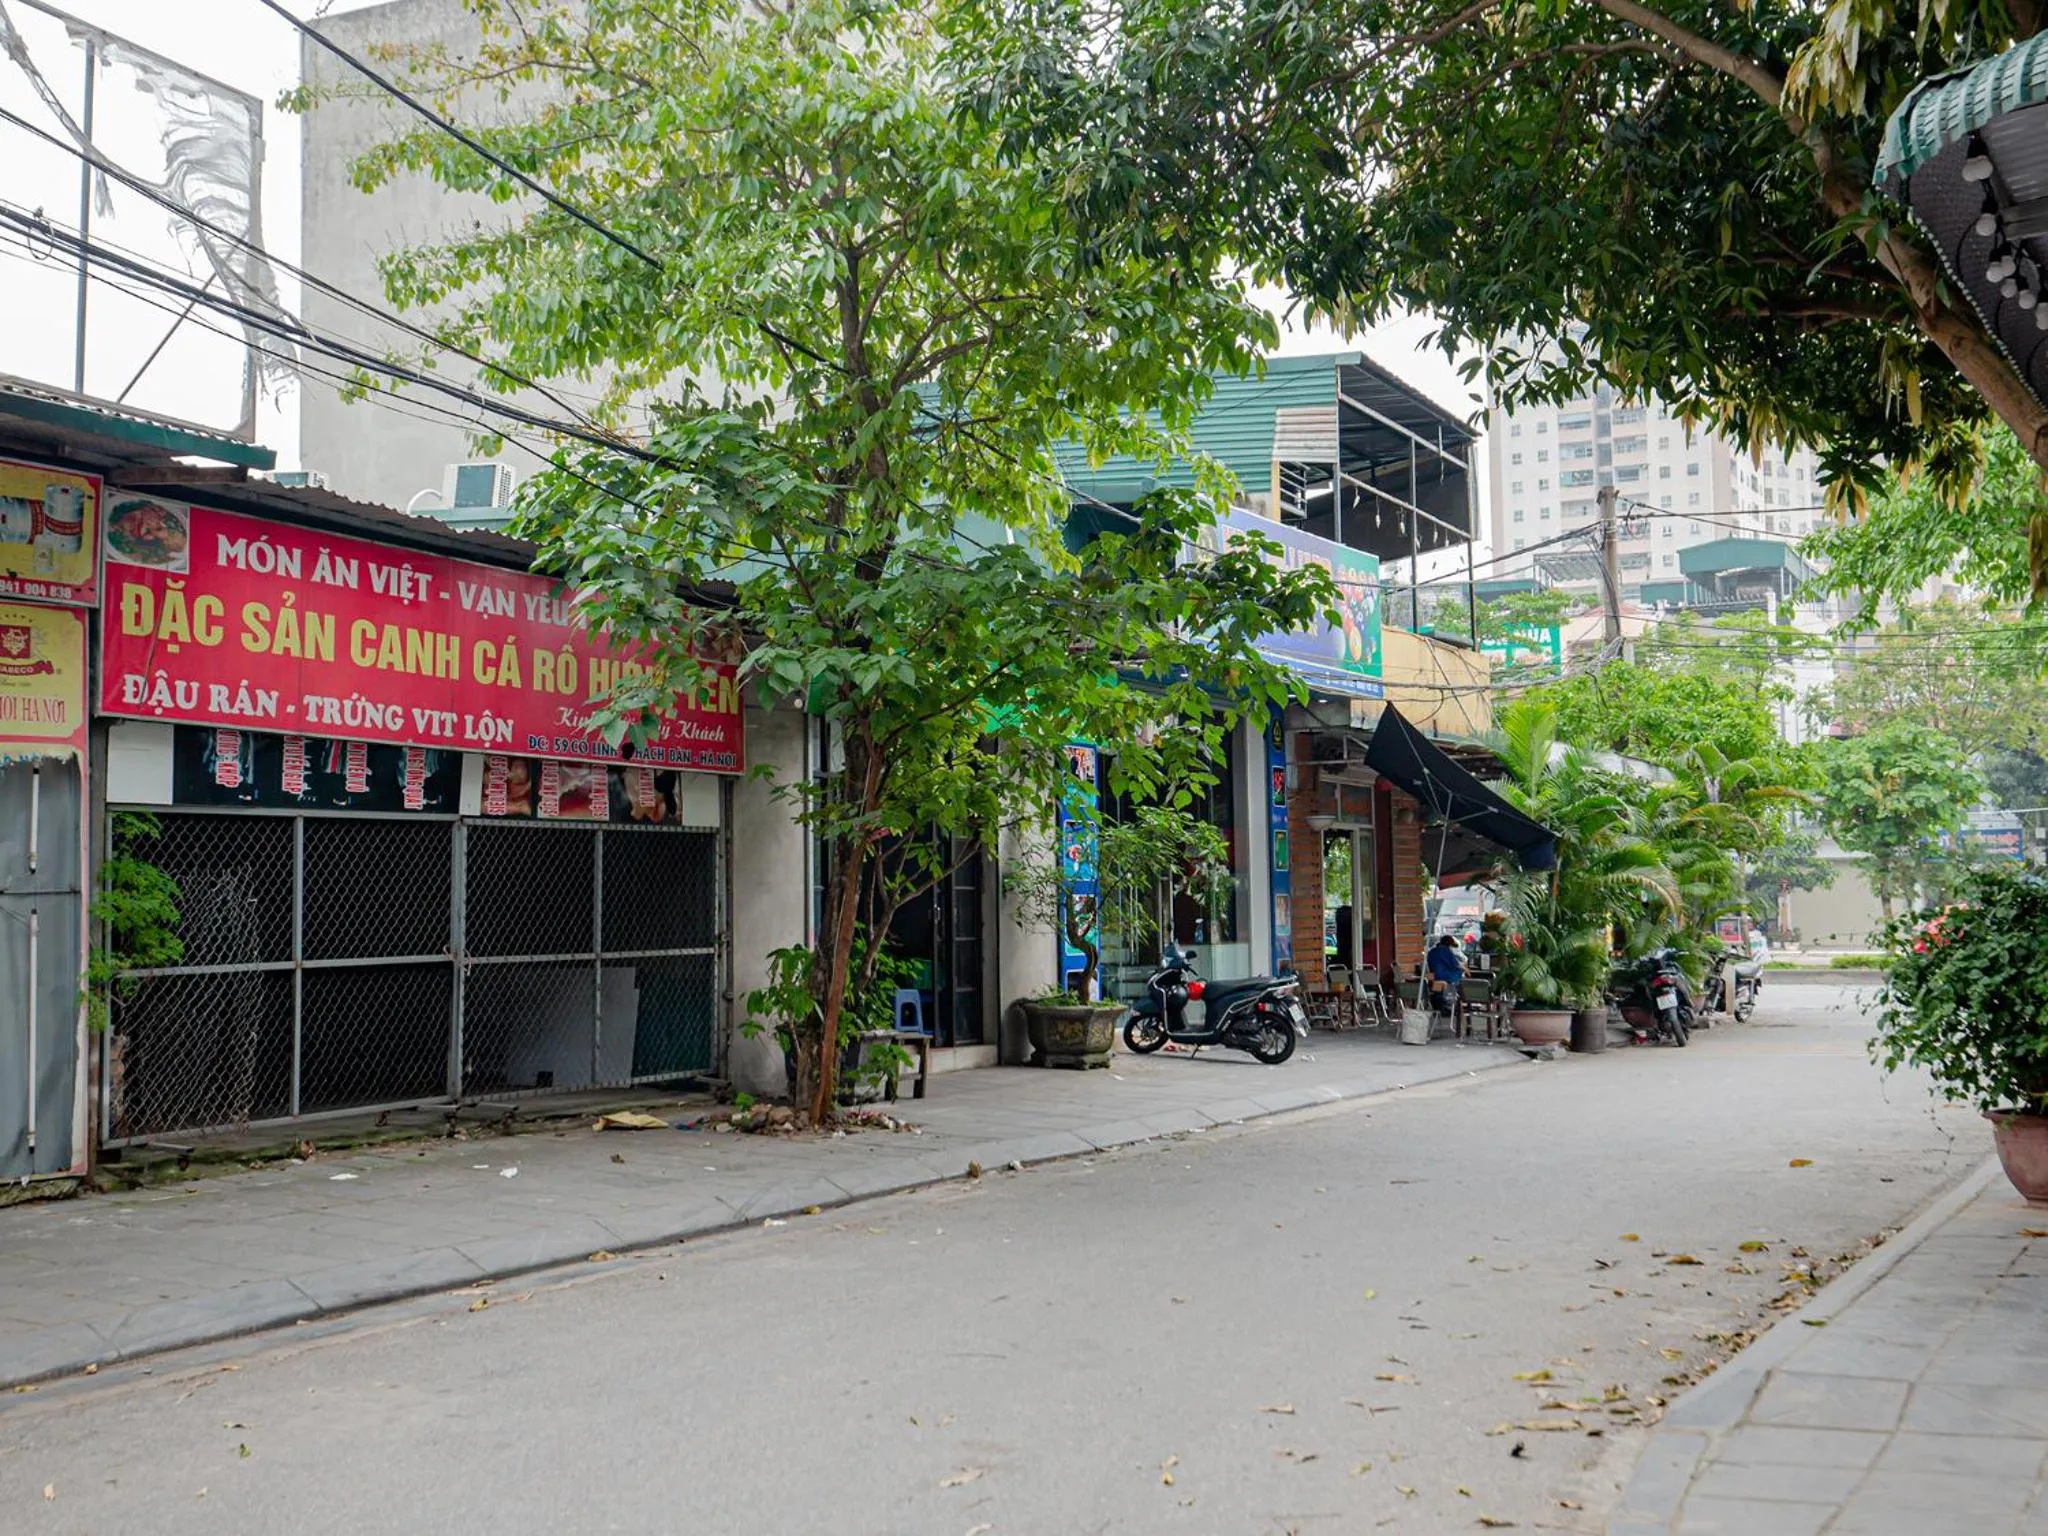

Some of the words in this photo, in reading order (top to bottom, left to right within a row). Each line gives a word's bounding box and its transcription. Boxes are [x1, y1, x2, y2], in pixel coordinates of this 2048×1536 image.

[216, 534, 302, 580] MÓN
[310, 547, 359, 590] ĂN
[367, 563, 433, 606] VIỆT
[458, 580, 516, 620] VẠN
[120, 577, 225, 654] ĐẶC
[240, 591, 335, 662] SẢN
[350, 618, 460, 680] CANH
[473, 634, 522, 689] CÁ
[533, 643, 578, 695] RÔ
[122, 669, 200, 715] ĐẬU
[208, 679, 279, 718] RÁN
[303, 692, 405, 732] TRỨNG
[464, 709, 514, 748] LỘN
[554, 737, 568, 752] 59
[675, 720, 725, 741] Khách
